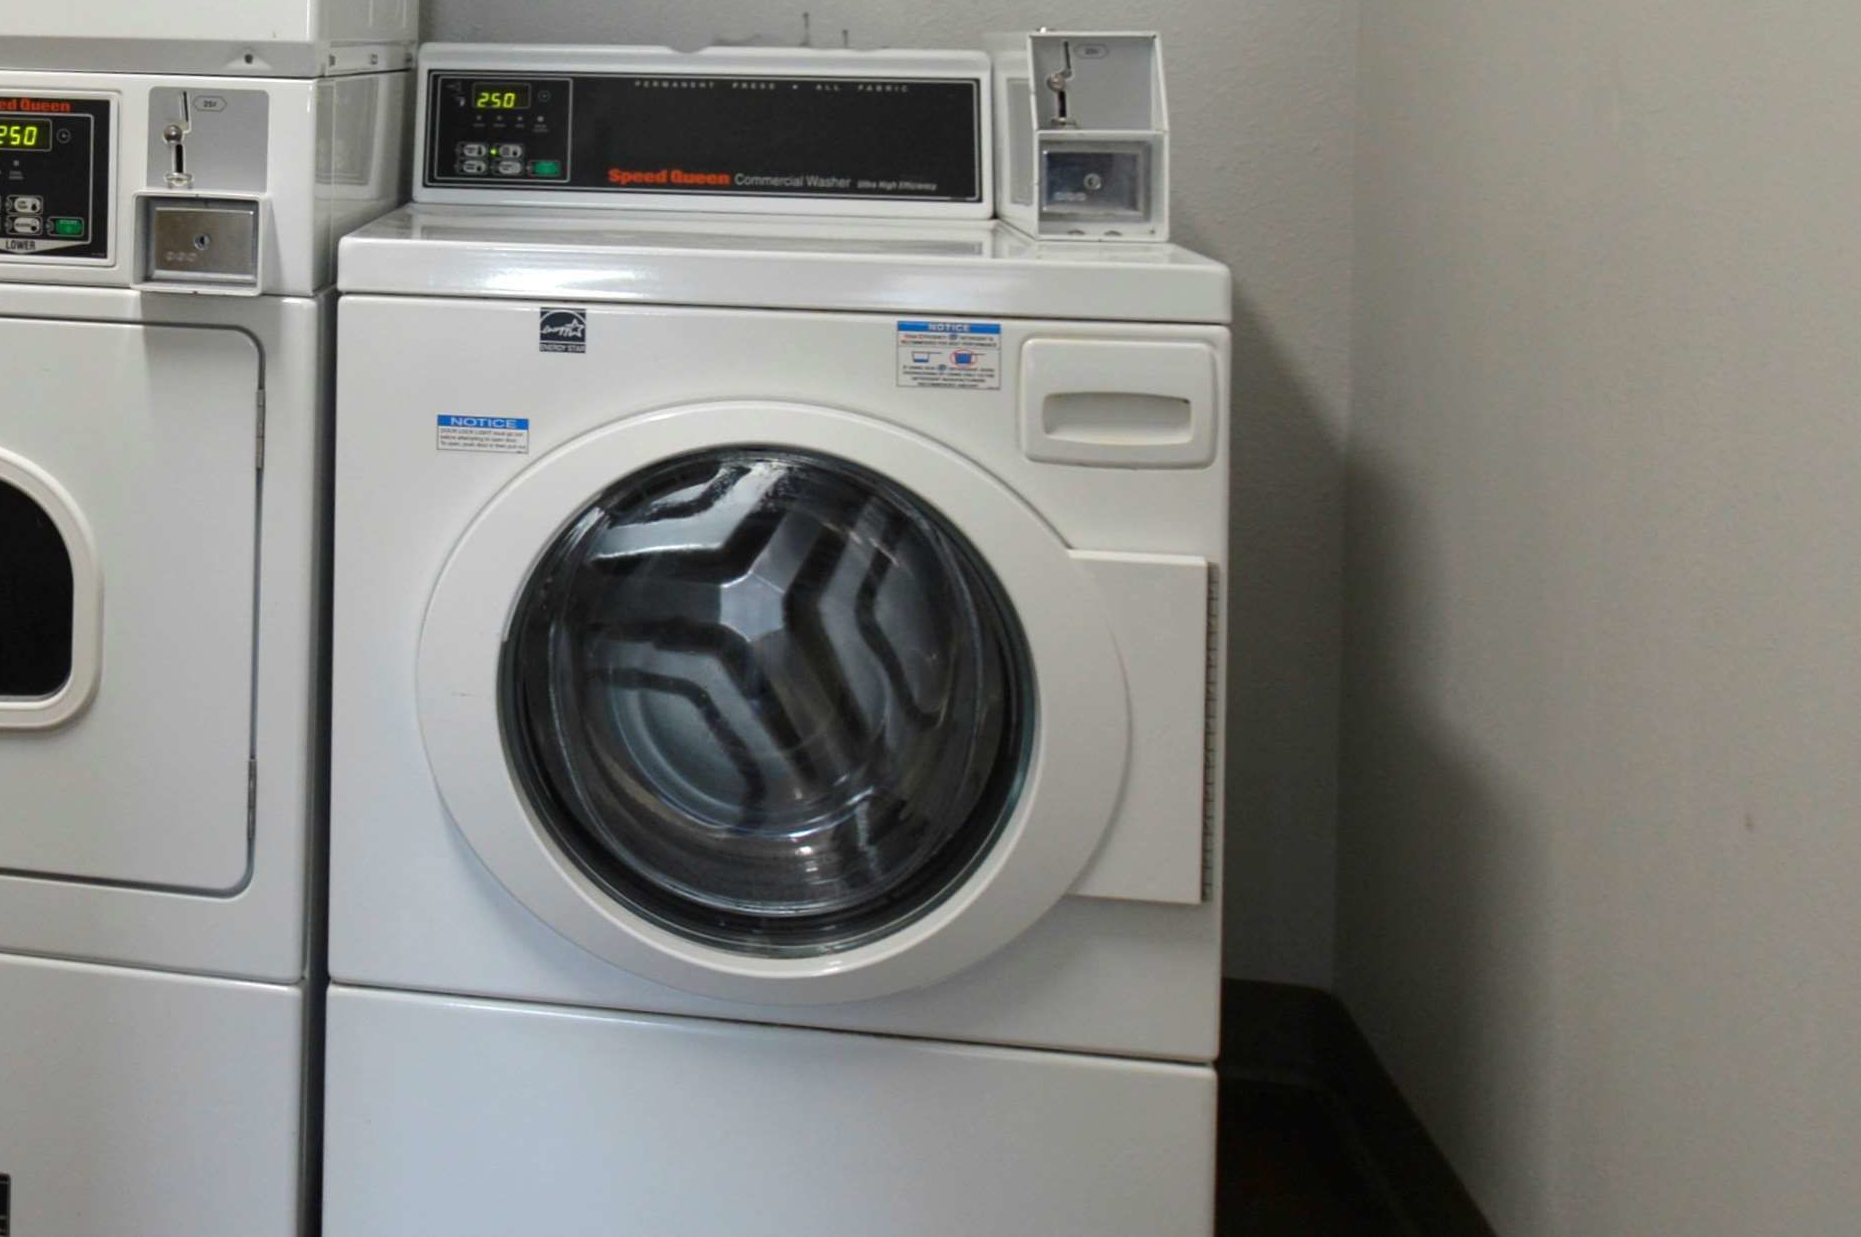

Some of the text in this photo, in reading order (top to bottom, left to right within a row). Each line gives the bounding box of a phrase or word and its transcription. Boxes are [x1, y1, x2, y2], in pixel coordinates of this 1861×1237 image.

[20, 98, 71, 112] Queen
[476, 91, 517, 108] 250
[608, 167, 668, 185] Speed
[670, 169, 731, 185] Queen
[735, 173, 803, 188] Commercial
[806, 175, 851, 188] Washer
[5, 240, 35, 250] LOWER
[928, 323, 970, 332] NOTICE
[450, 417, 516, 429] NOTICE
